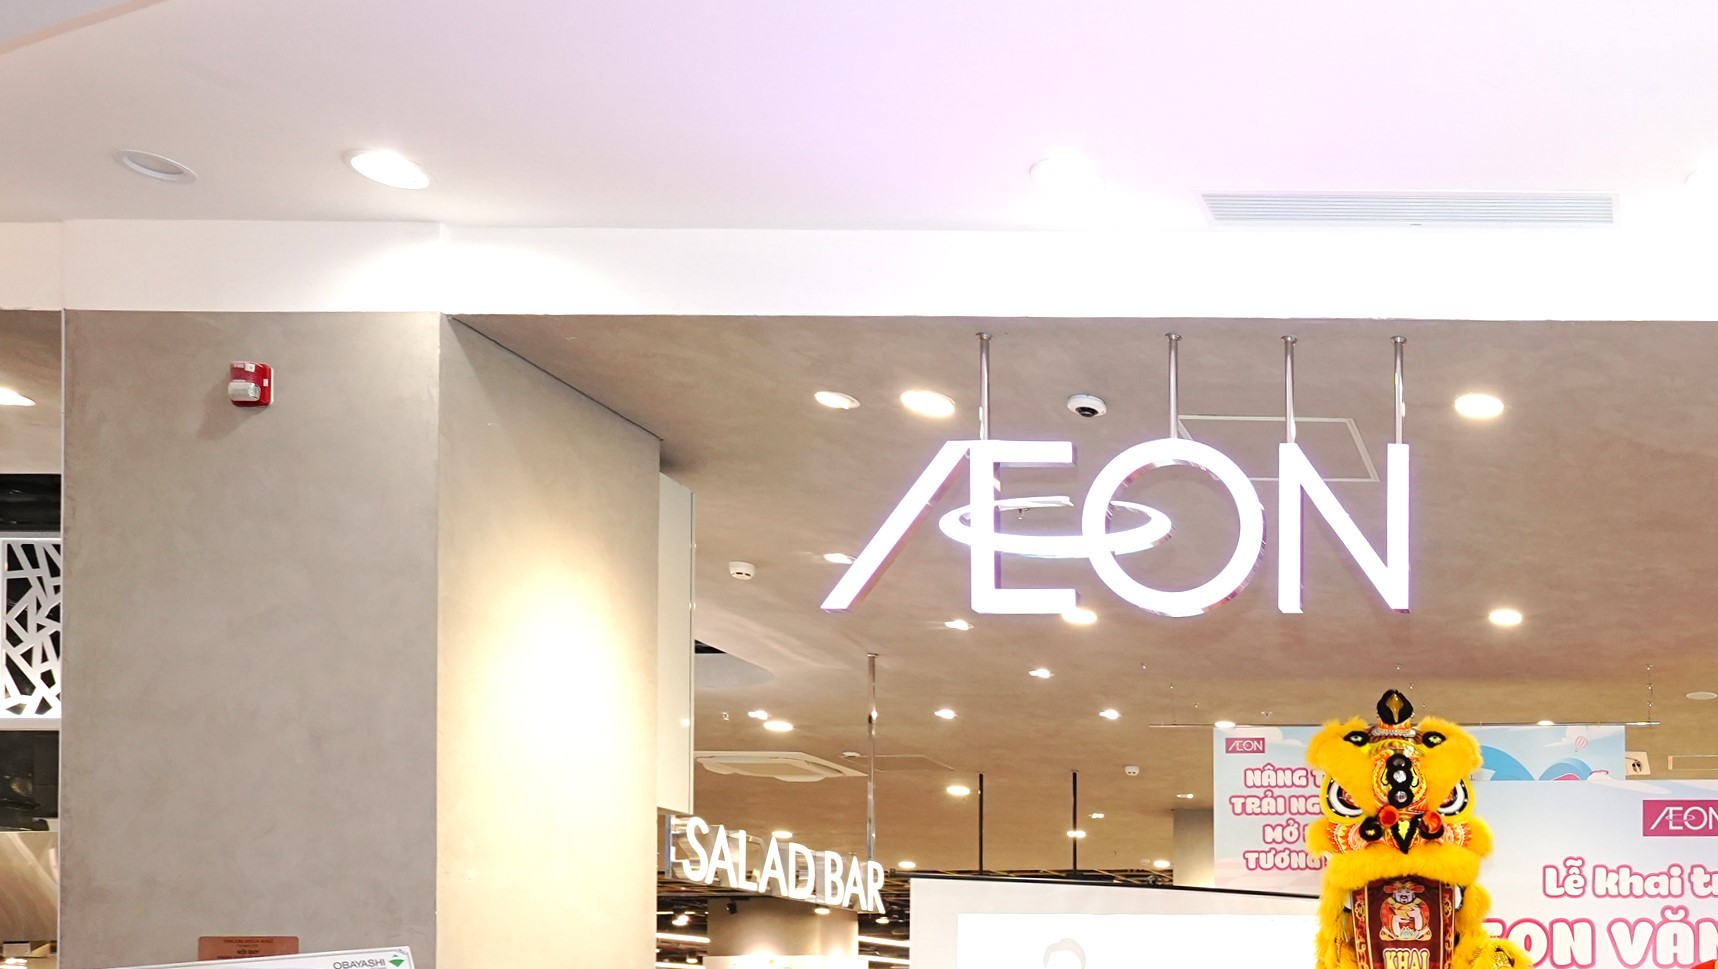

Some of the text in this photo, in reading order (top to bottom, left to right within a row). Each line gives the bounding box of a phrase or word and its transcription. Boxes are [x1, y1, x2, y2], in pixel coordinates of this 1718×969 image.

[1244, 763, 1308, 788] NÂNG
[1229, 789, 1287, 815] TRẢI
[1263, 818, 1300, 844] MỞ
[671, 816, 886, 914] SALAD BAR
[1542, 855, 1588, 898] Lễ
[1592, 863, 1685, 898] khai
[332, 958, 387, 969] OBAYASHI
